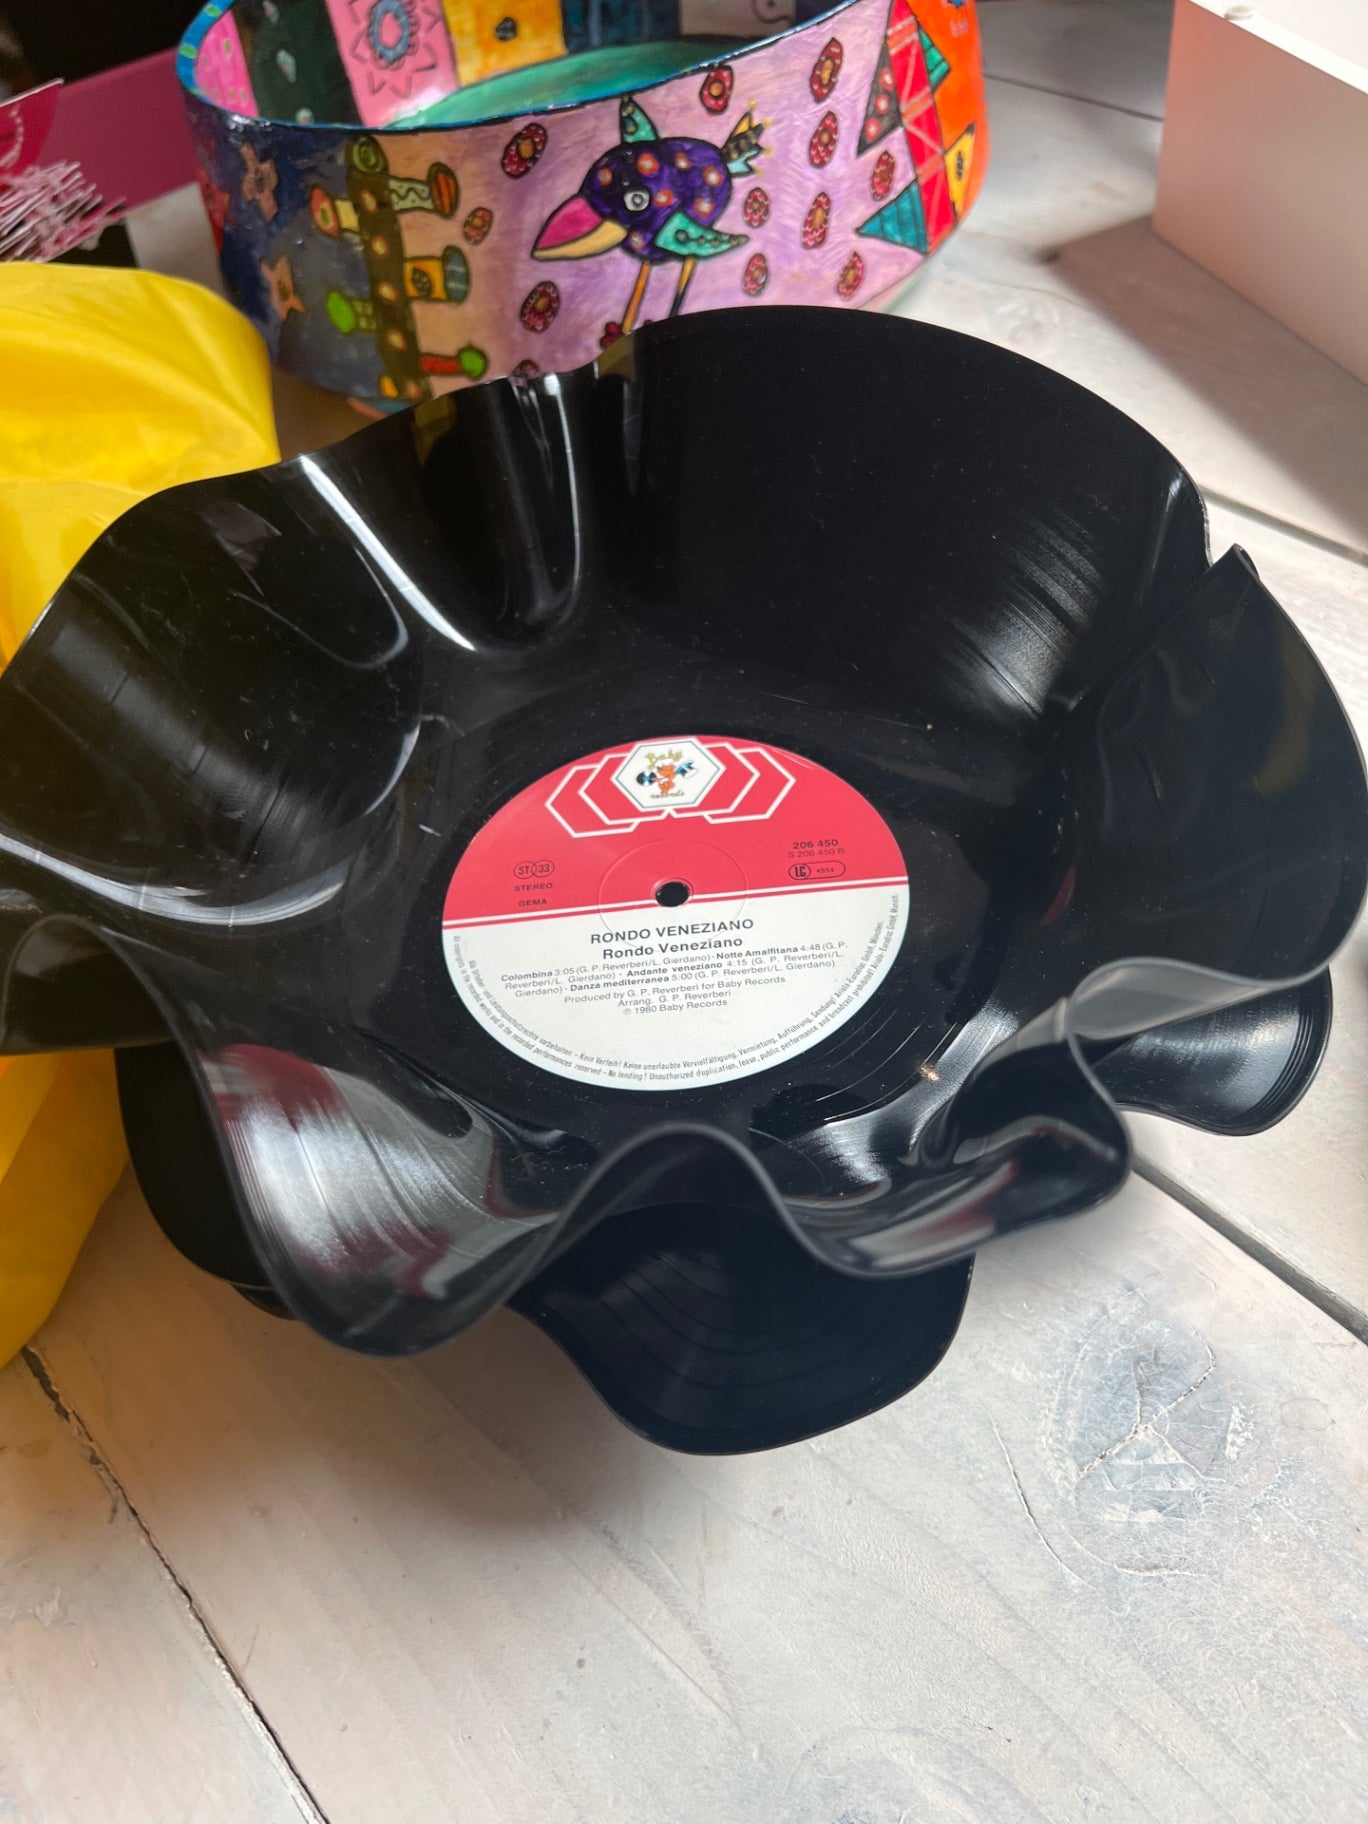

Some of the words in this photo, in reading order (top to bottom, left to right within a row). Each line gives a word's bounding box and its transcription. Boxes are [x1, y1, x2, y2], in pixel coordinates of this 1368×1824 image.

[793, 841, 814, 850] 206
[817, 838, 838, 847] 450
[797, 850, 815, 858] 206
[818, 848, 835, 856] 450
[518, 865, 529, 875] ST
[538, 864, 550, 873] 33
[514, 882, 553, 892] STEREO
[518, 898, 547, 907] GEMA
[590, 928, 651, 944] RONDO
[656, 918, 754, 938] VENEZIANO
[603, 946, 654, 960] Rondo
[658, 938, 743, 954] Veneziano
[501, 970, 552, 982] Colombina
[554, 968, 574, 976] 3:05
[716, 952, 744, 960] Notte
[745, 946, 798, 956] Amalfitana
[800, 943, 821, 952] 4:48
[626, 968, 668, 977] Andante
[672, 962, 722, 972] veneziano
[726, 960, 748, 968] 4:15
[564, 992, 610, 1004] Produced
[614, 992, 625, 1000] by
[628, 990, 638, 998] G.
[640, 988, 650, 996] P.
[652, 985, 699, 995] Reverberi
[702, 982, 715, 990] for
[718, 978, 742, 989] Baby
[744, 976, 786, 986] Records
[570, 982, 600, 992] Danza
[604, 976, 670, 988] mediterranea
[672, 972, 692, 981] 5:00
[618, 998, 654, 1007] Arrang.
[672, 994, 682, 1002] P.
[684, 990, 731, 1000] Reverberi
[635, 1006, 657, 1014] 1980
[660, 1003, 684, 1012] Baby
[686, 999, 728, 1009] Records
[649, 1070, 694, 1080] Unauthorized
[759, 1047, 780, 1061] public
[780, 1026, 818, 1051] performance
[623, 1061, 642, 1070] Keine
[643, 1062, 681, 1070] unerlaubte
